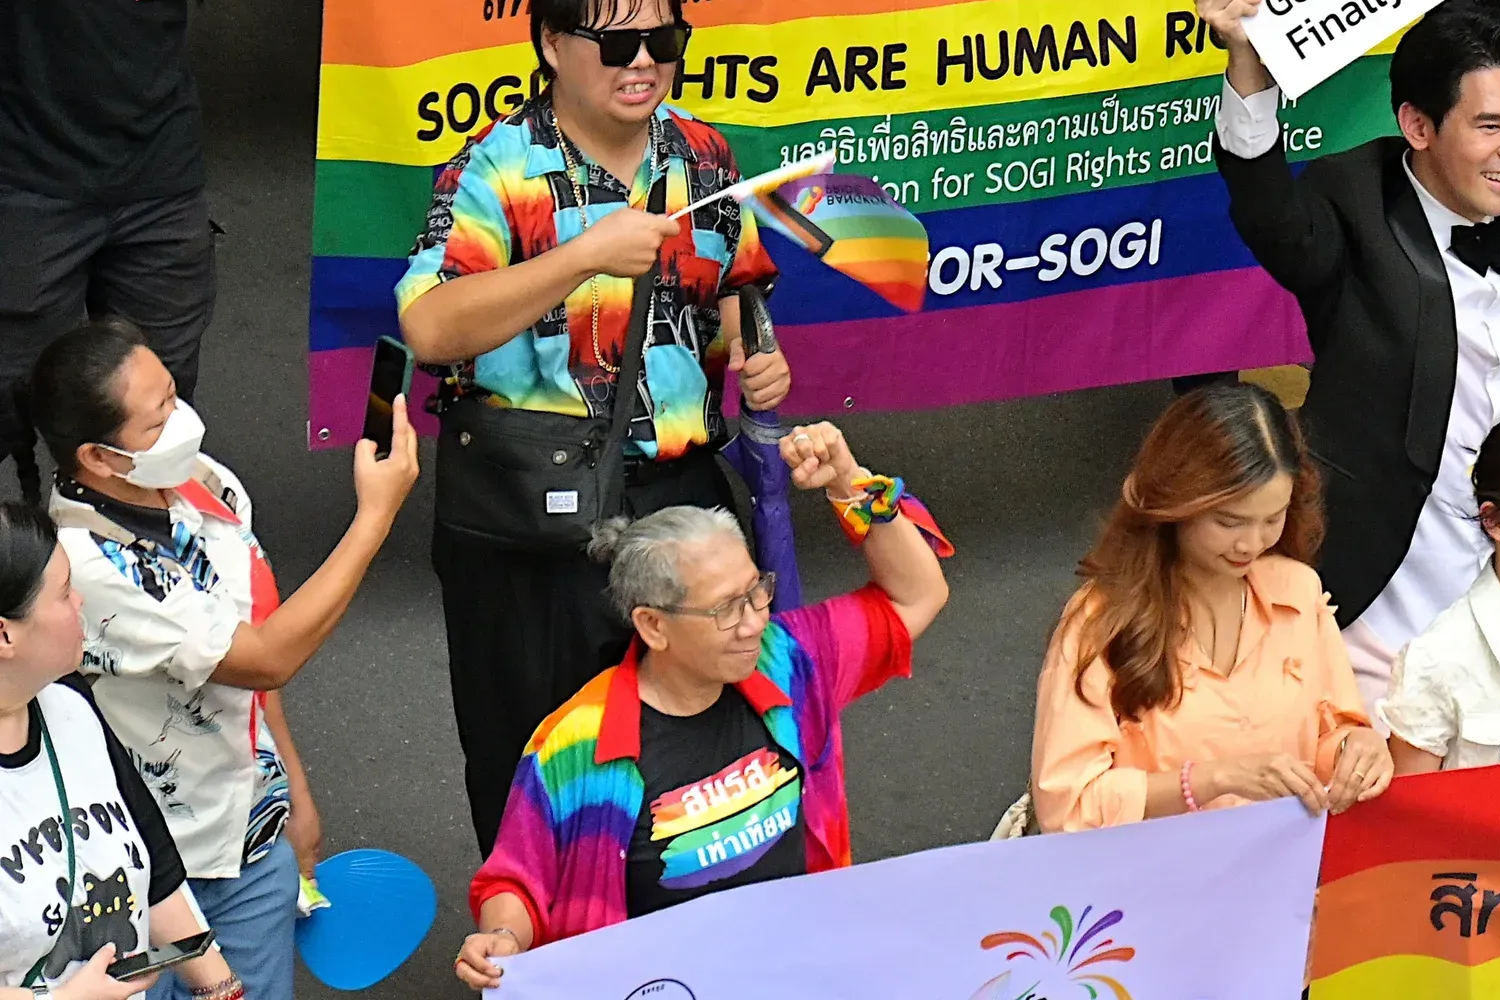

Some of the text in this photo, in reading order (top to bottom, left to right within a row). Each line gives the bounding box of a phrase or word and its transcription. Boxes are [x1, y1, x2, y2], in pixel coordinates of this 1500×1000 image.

[806, 42, 907, 98] ARE
[936, 15, 1139, 87] HUMAN
[931, 167, 975, 199] for
[985, 157, 1056, 194] SOGI
[1066, 147, 1151, 190] Rights
[1160, 139, 1214, 176] and
[681, 758, 769, 817] สมรส
[696, 807, 793, 867] เท่าเทียม
